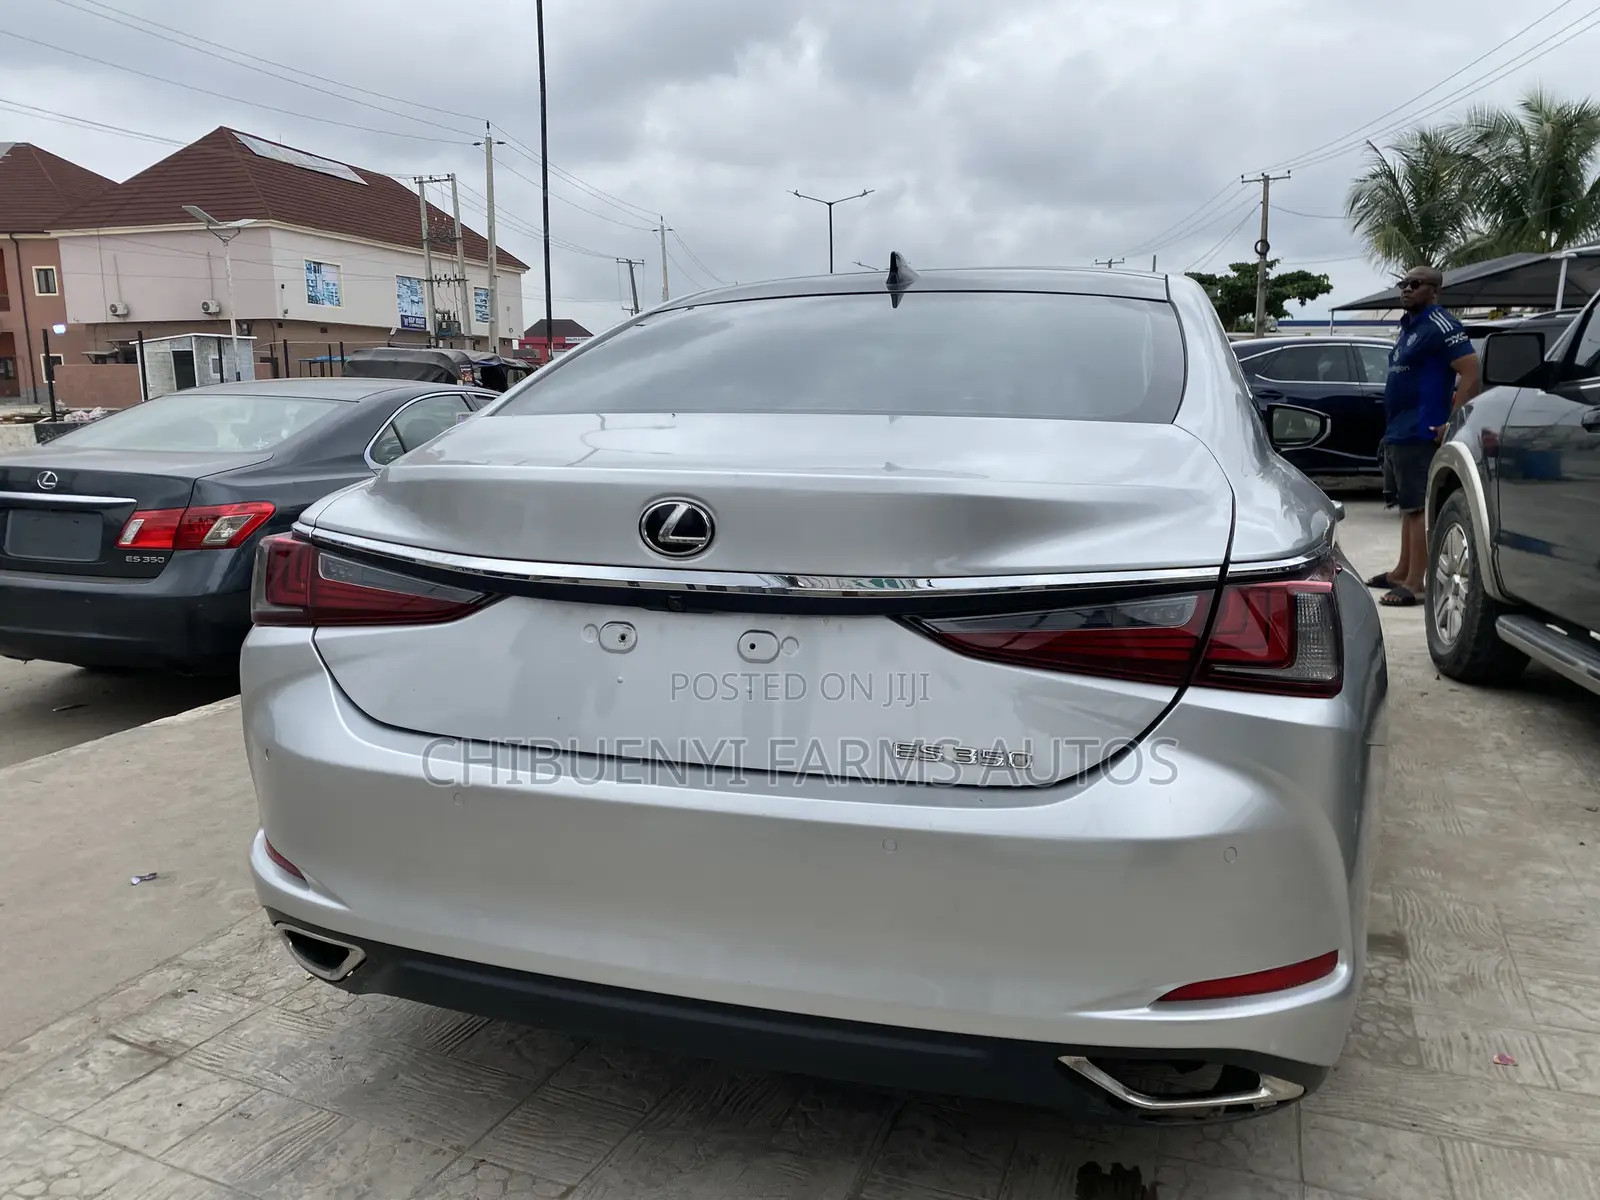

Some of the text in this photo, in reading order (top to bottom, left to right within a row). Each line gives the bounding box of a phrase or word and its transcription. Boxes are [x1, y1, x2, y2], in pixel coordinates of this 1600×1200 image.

[125, 555, 165, 564] ES 350
[893, 742, 1034, 769] ES 350
